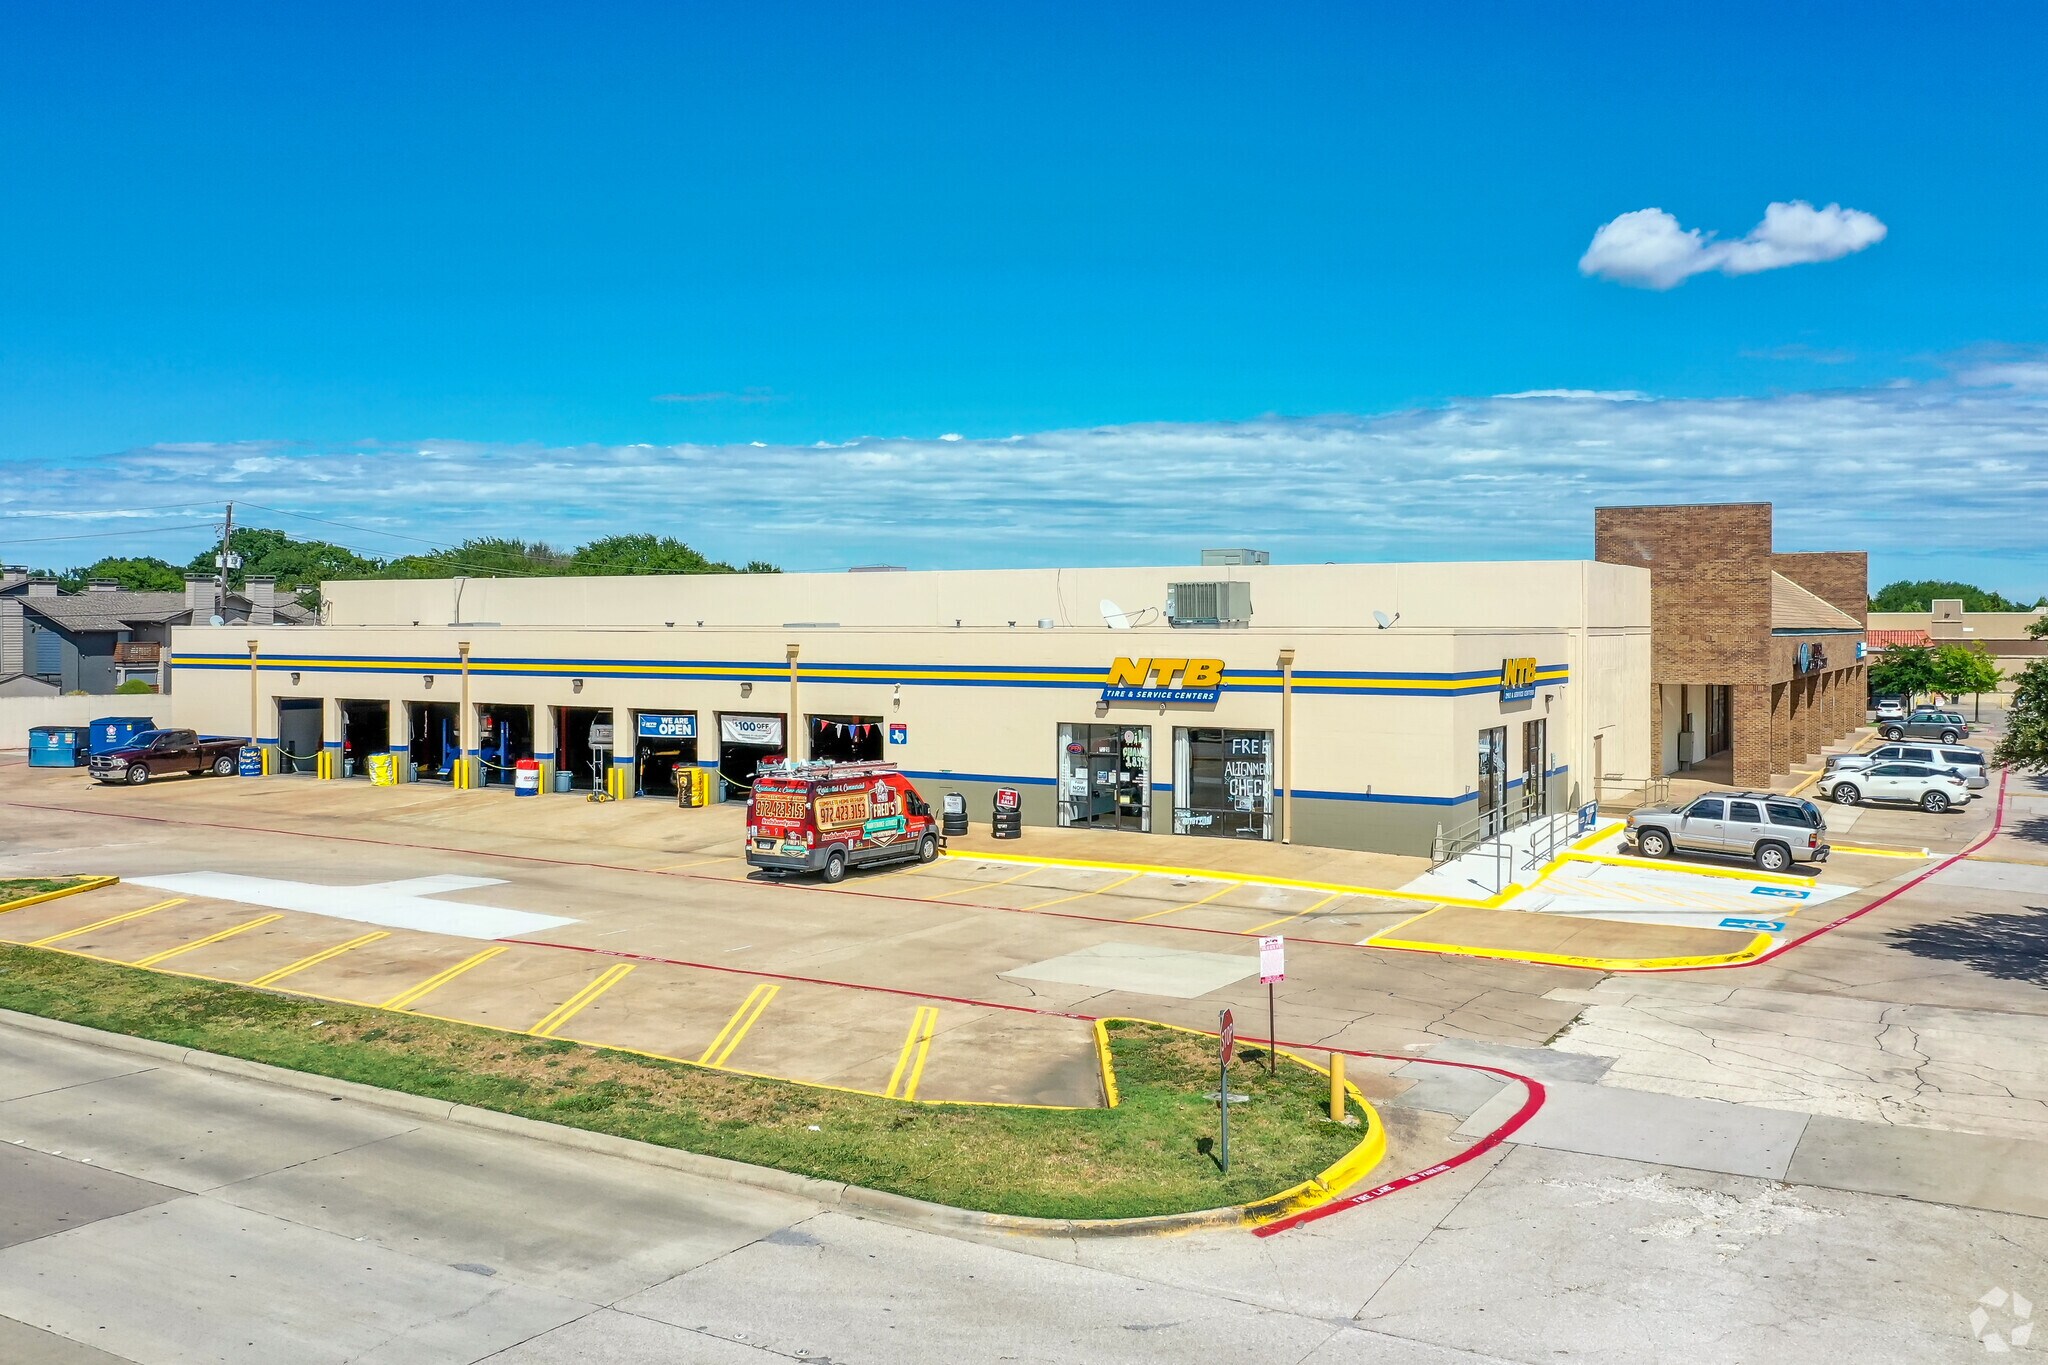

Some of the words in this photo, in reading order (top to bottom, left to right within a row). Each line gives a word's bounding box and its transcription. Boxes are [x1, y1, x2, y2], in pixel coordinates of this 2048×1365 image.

[1106, 657, 1225, 687] NTB
[1505, 657, 1536, 685] NTB
[1174, 692, 1214, 700] CENTERS
[659, 724, 692, 735] OPEN
[674, 717, 689, 725] ARE
[735, 721, 756, 732] $100
[1232, 738, 1271, 755] FREE
[1229, 778, 1272, 797] CHECK
[756, 800, 806, 819] 972.423.3153
[820, 803, 866, 824] 972.423.3153
[873, 802, 896, 818] FRED'S
[1221, 1022, 1233, 1052] STOP
[1352, 1194, 1373, 1203] FIRE
[1372, 1185, 1395, 1195] LANE
[1418, 1164, 1450, 1177] PARKING
